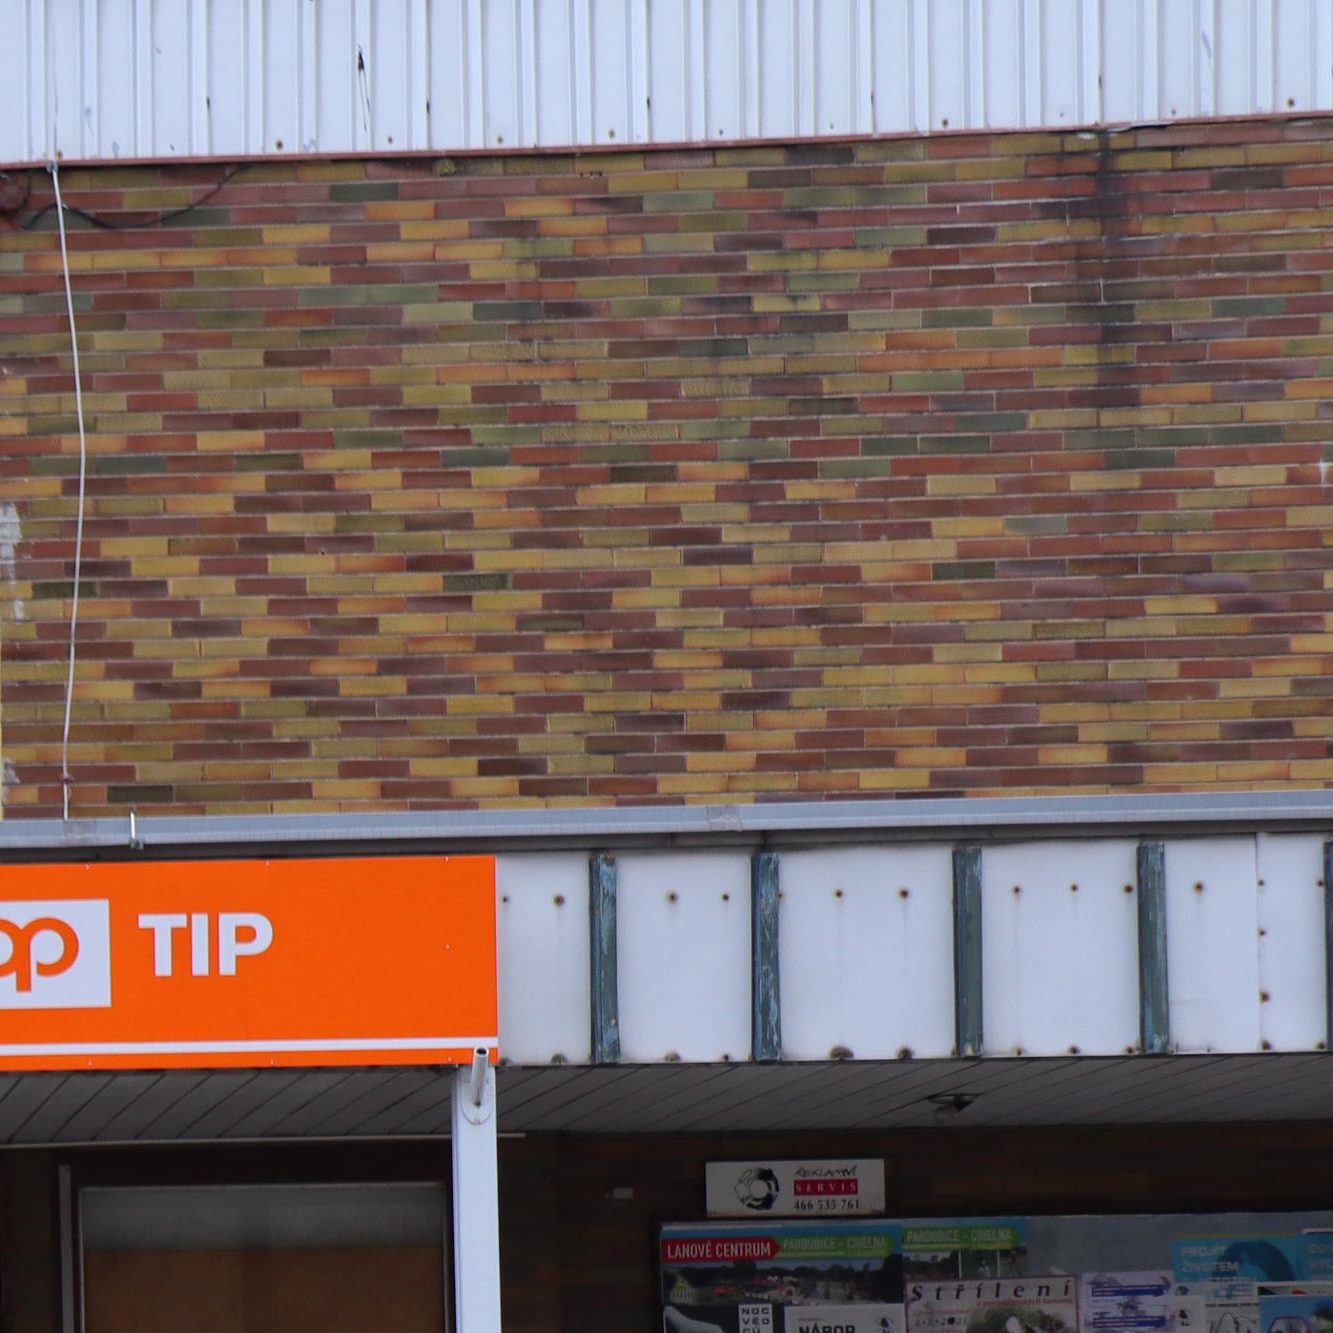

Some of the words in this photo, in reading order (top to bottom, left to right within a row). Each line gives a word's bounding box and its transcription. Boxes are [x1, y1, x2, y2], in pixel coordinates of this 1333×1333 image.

[137, 911, 274, 978] TIP
[795, 1181, 856, 1193] SERVIS
[794, 1200, 813, 1210] 466
[841, 1199, 859, 1209] 761
[907, 1229, 960, 1242] PARDUBICE
[666, 1241, 711, 1259] LANOVÉ
[714, 1241, 771, 1258] CENTRUM
[783, 1238, 835, 1251] PARDUBICE
[911, 1278, 1071, 1302] Střílení
[741, 1307, 770, 1315] NOC
